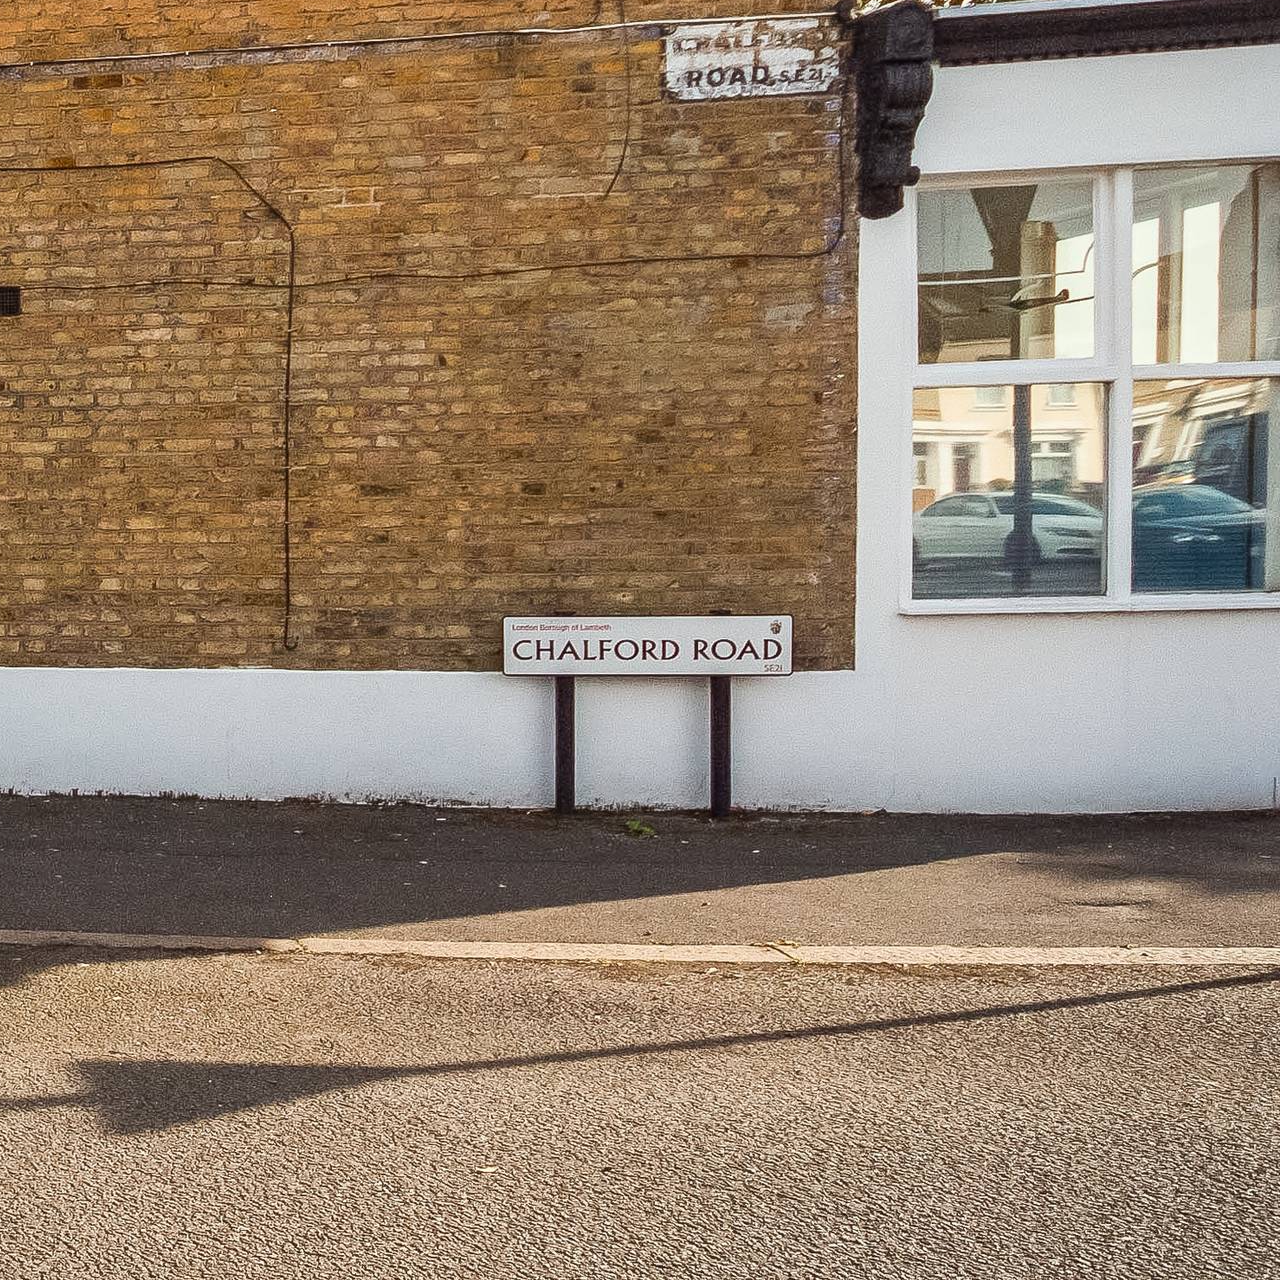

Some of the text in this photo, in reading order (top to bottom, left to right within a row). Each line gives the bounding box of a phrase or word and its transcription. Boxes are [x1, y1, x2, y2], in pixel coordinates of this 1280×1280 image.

[686, 65, 770, 88] ROAD
[540, 624, 570, 632] Borough
[512, 638, 783, 661] CHALFORD ROAD
[764, 664, 783, 672] SE21
